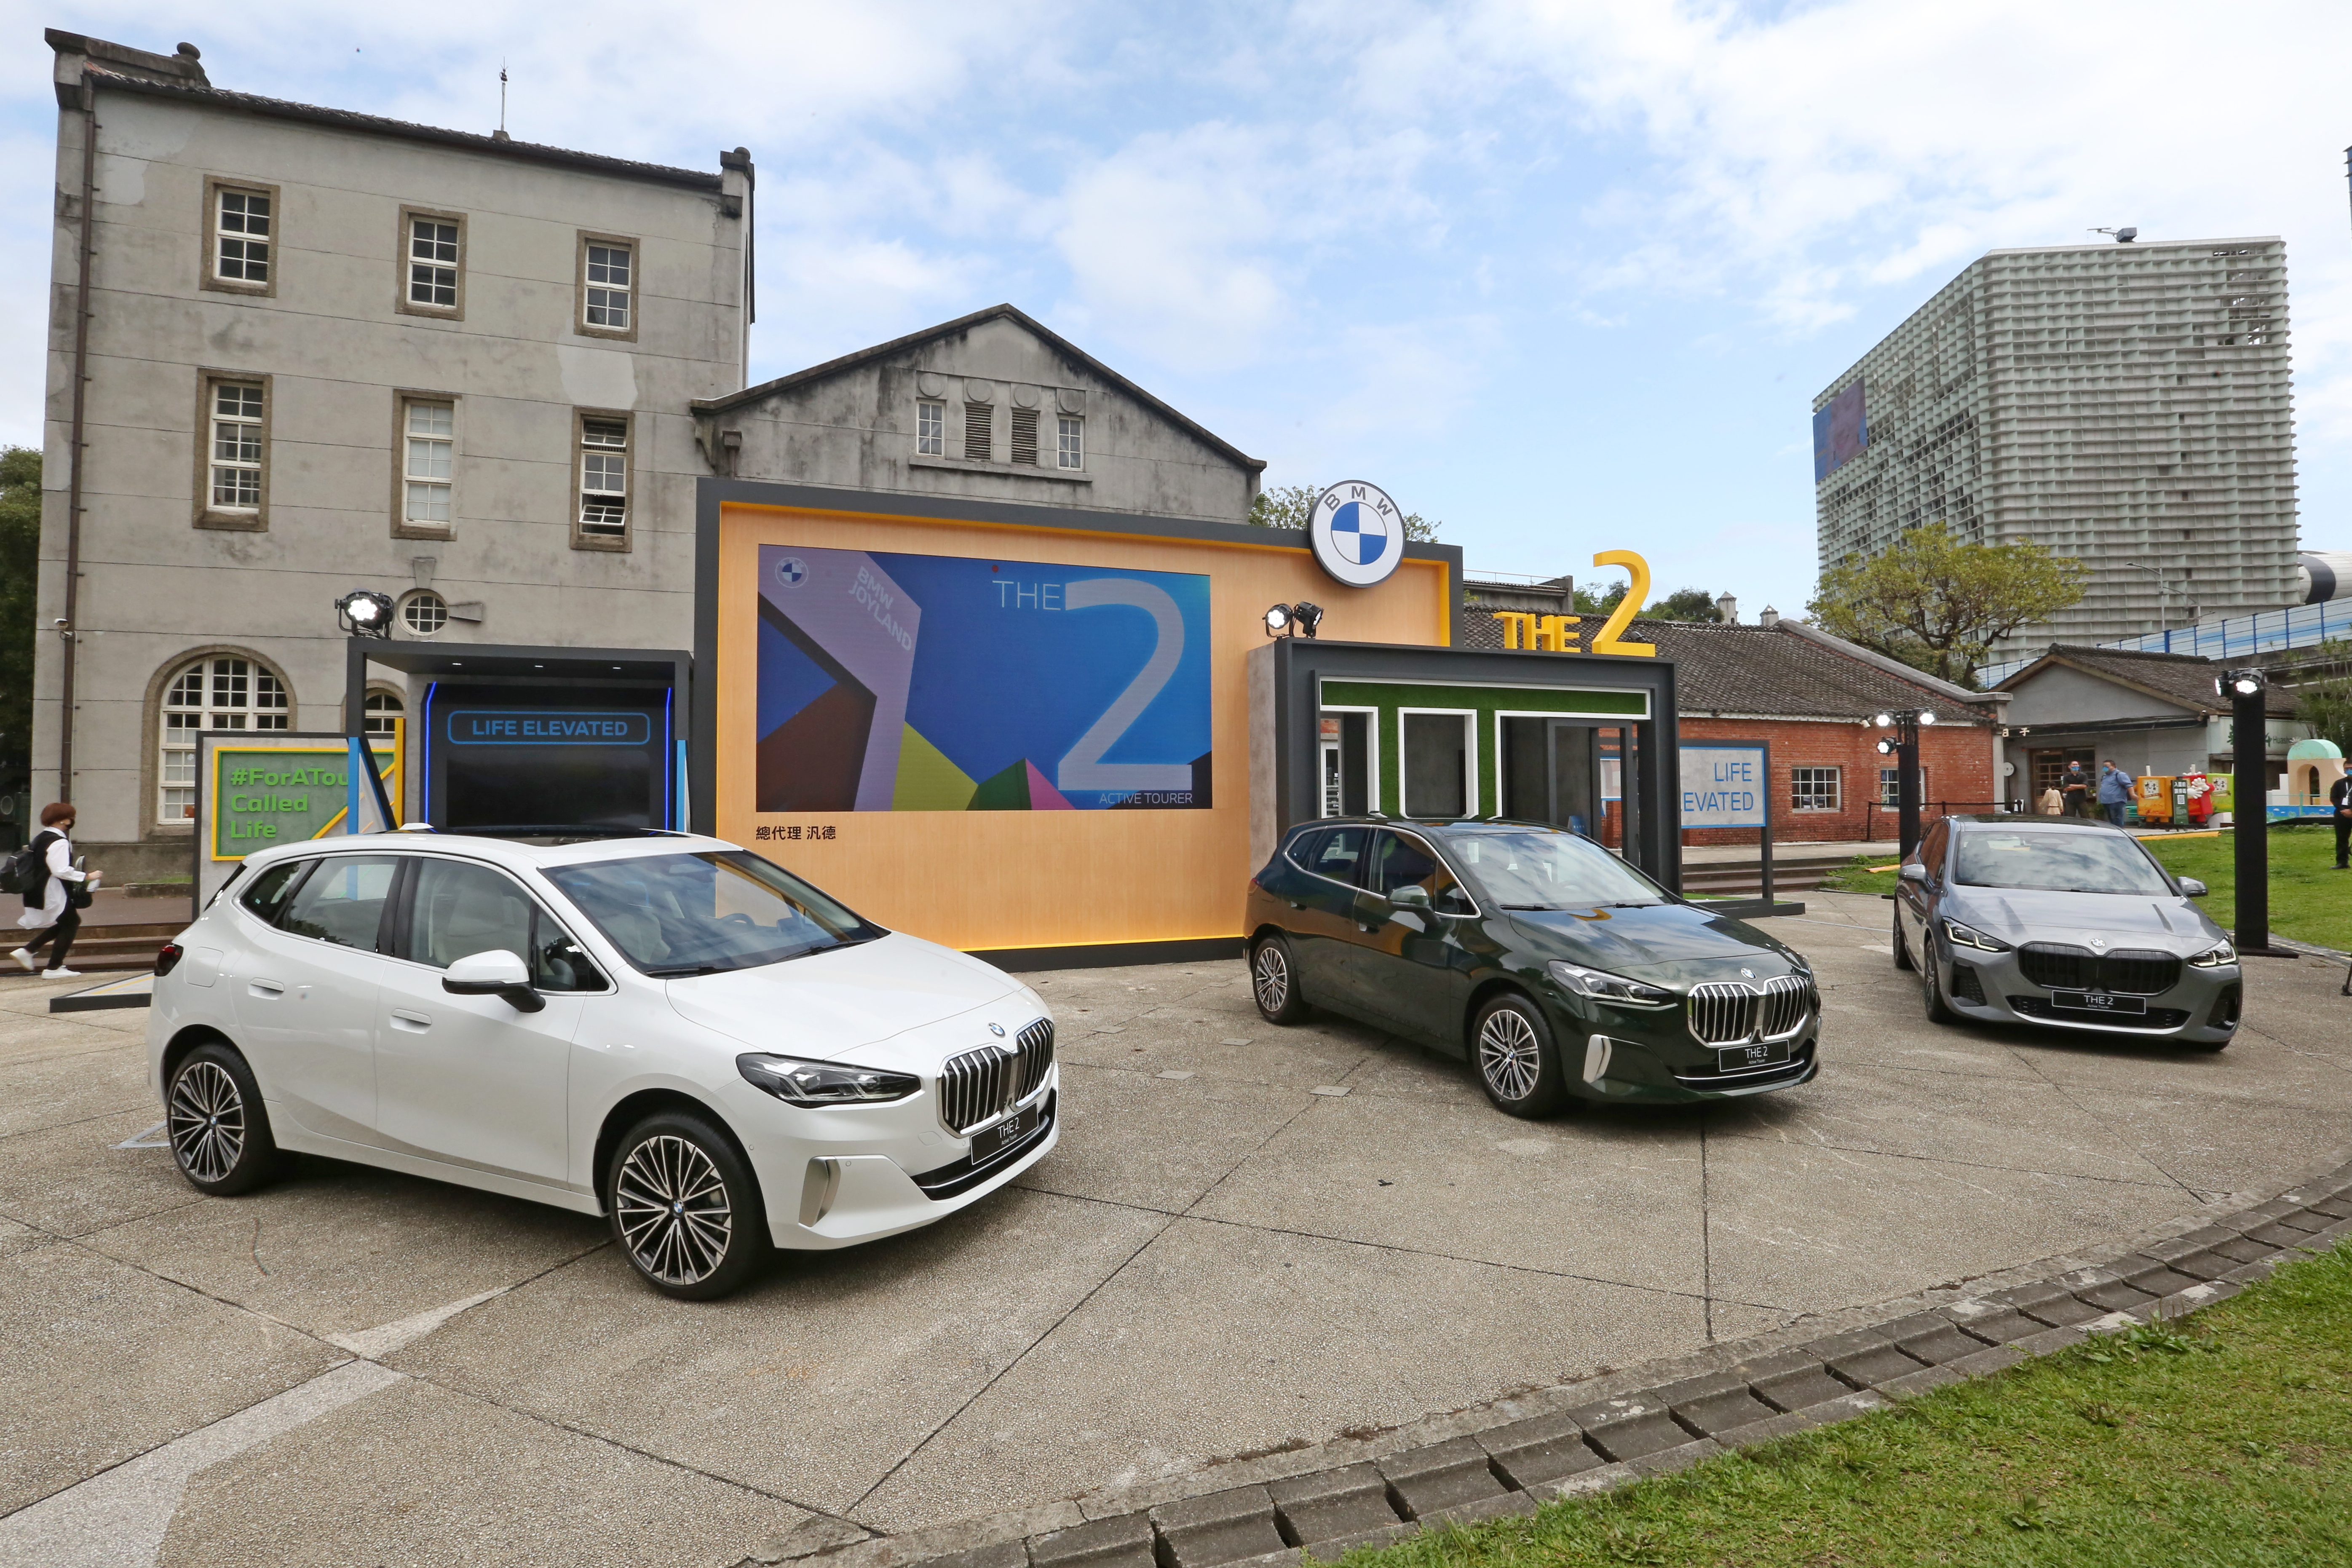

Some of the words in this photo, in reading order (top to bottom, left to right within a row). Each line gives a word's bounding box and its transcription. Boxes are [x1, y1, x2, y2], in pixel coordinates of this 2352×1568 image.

[1324, 485, 1393, 517] BMW
[857, 566, 894, 610] BMW
[1493, 611, 1581, 653] THE
[1591, 549, 1656, 657] 2
[848, 581, 912, 651] JOYLAND
[992, 580, 1061, 611] THE
[1057, 578, 1192, 791] 2
[472, 720, 517, 735] LIFE
[523, 720, 628, 736] ELEVATED
[1714, 763, 1752, 781] LIFE
[230, 794, 308, 812] Called
[1099, 793, 1142, 804] ACTIVE
[1144, 793, 1193, 804] TOURER
[1682, 792, 1754, 812] EVATED
[230, 820, 277, 838] Life
[755, 826, 802, 840] 總代理
[2084, 995, 2105, 1004] THE
[2107, 997, 2114, 1005] 2
[1745, 1047, 1762, 1059] THE
[1763, 1046, 1768, 1056] 2
[997, 1120, 1014, 1138] THE
[1015, 1117, 1020, 1130] 2
